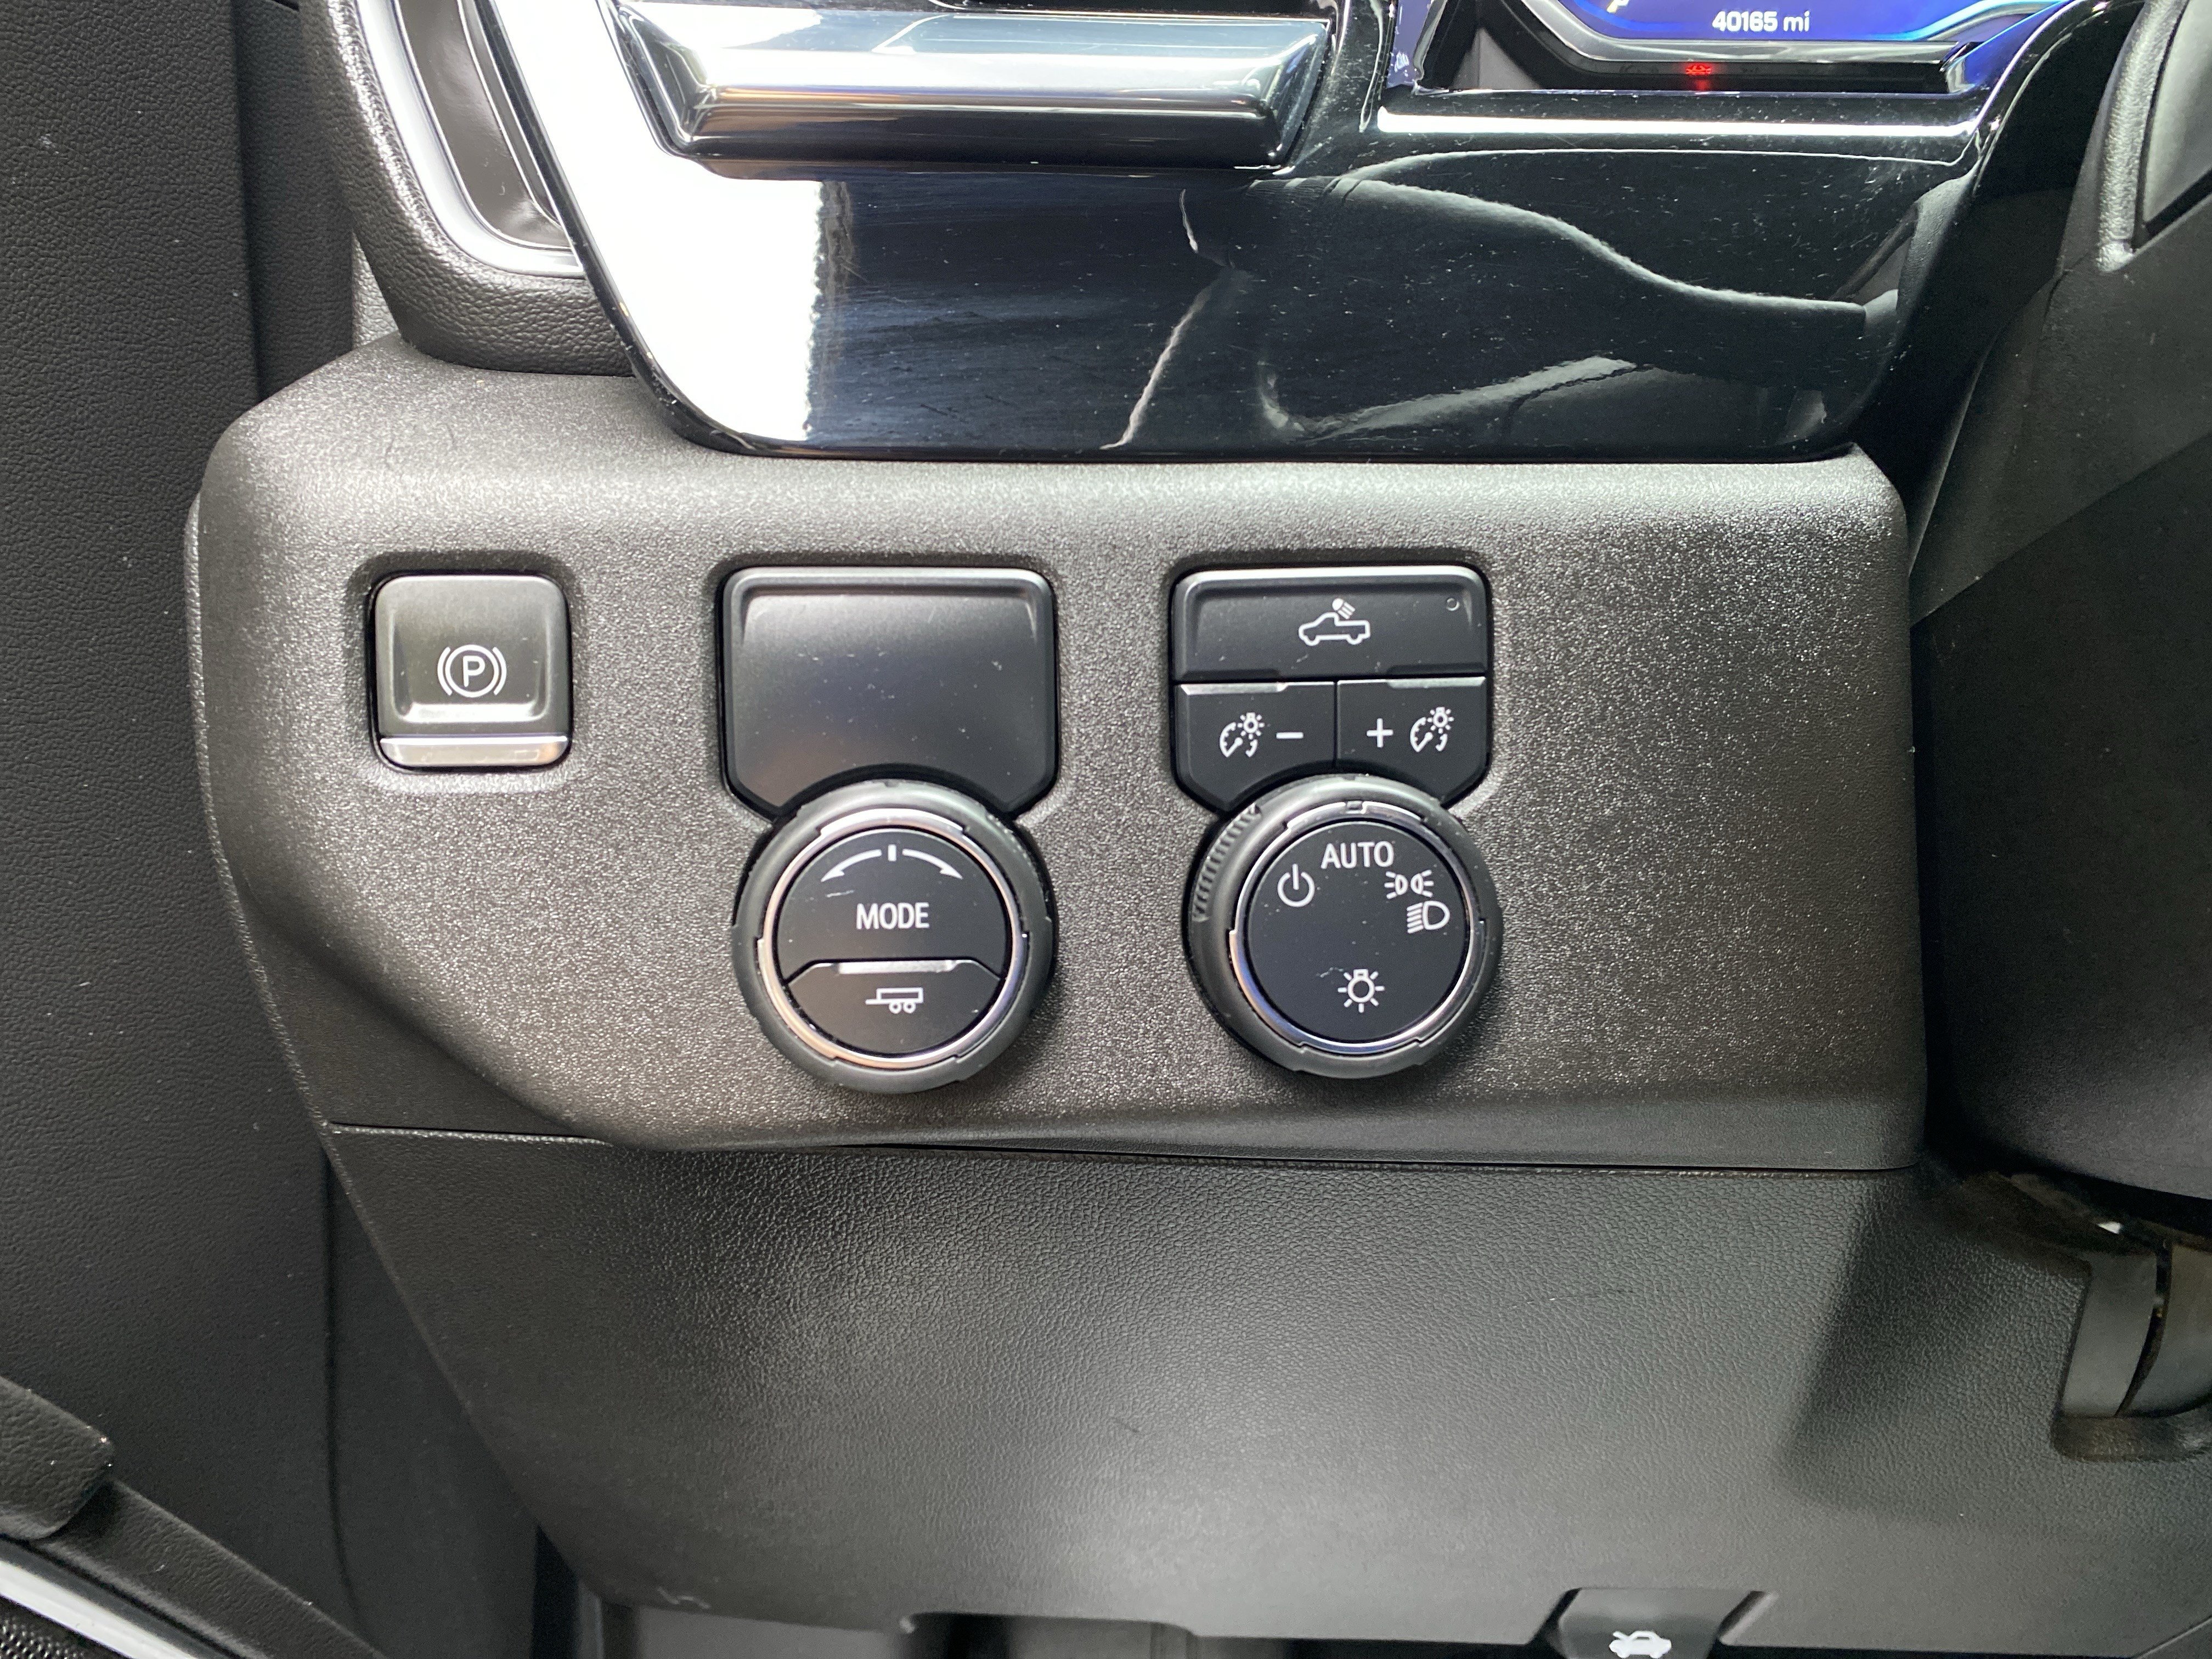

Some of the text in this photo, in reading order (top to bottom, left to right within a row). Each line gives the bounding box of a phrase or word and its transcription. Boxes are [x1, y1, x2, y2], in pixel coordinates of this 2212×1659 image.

[1712, 10, 1810, 32] 40165 mi
[1321, 840, 1395, 869] AUTO
[856, 902, 930, 930] MODE
